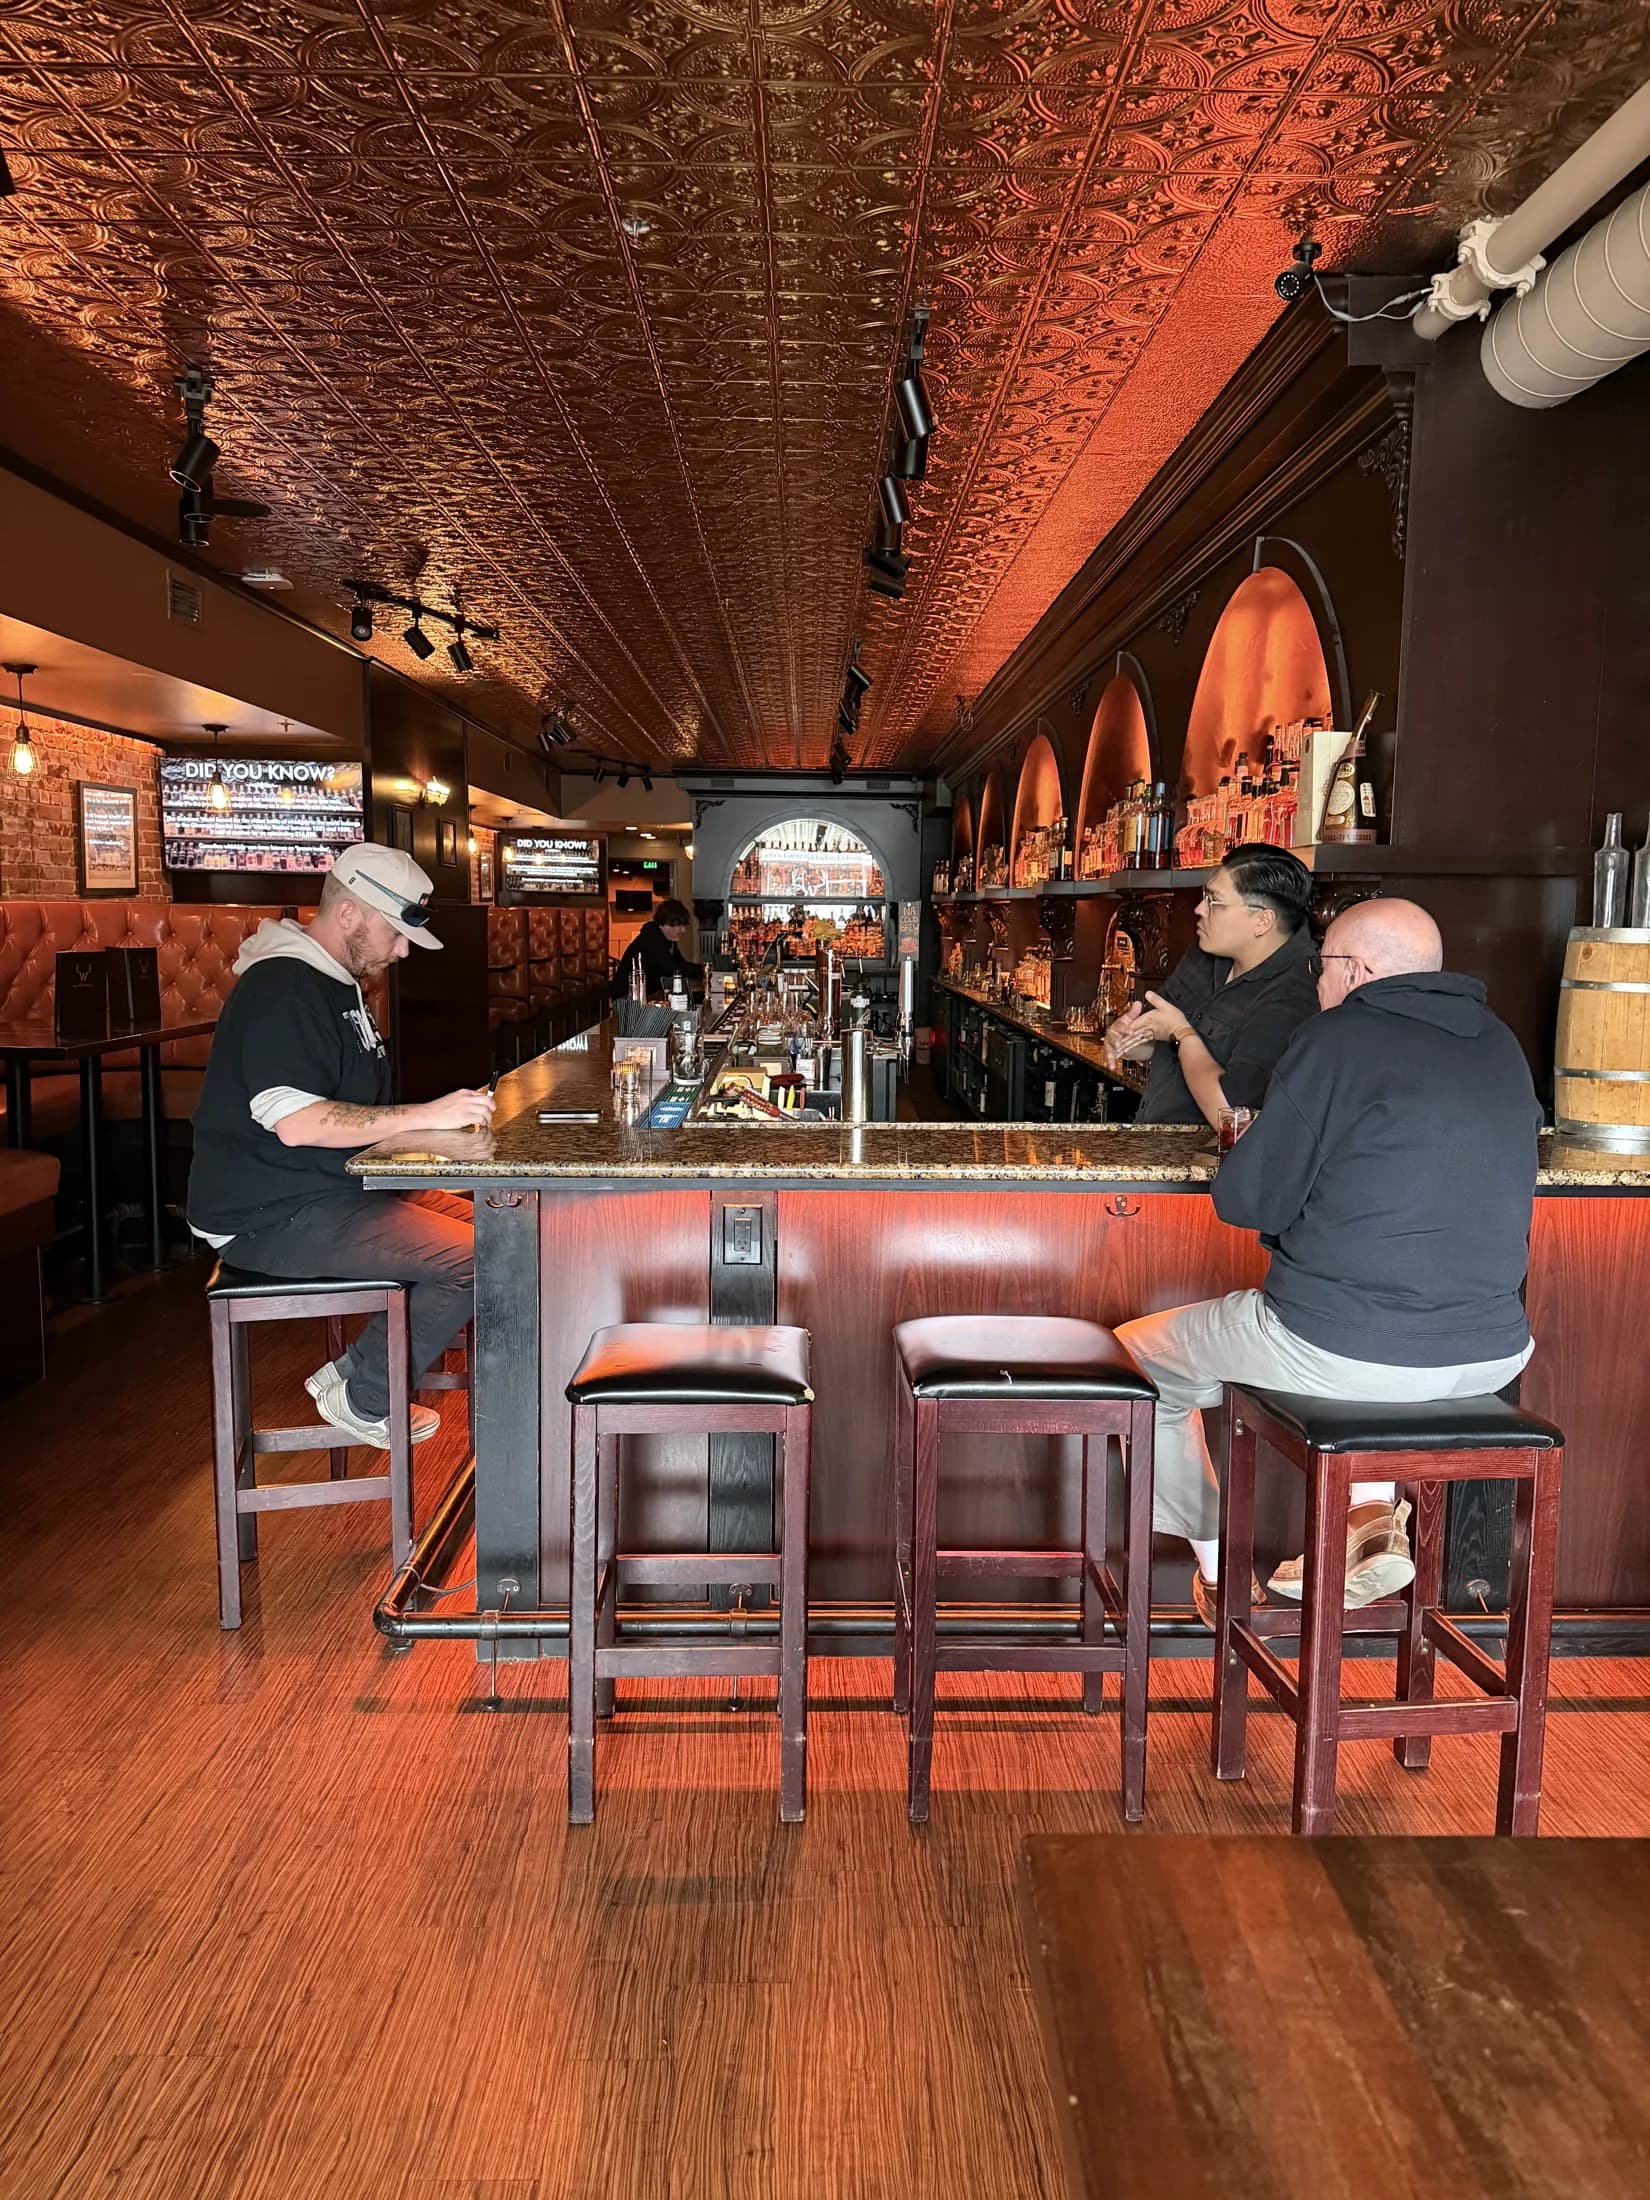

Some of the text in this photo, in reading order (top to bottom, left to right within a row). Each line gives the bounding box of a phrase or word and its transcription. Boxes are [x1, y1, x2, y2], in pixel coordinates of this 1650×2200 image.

[186, 762, 336, 781] DID YOU KNOW?
[517, 838, 587, 850] DID YOU KNOW?
[900, 916, 918, 924] COLD
